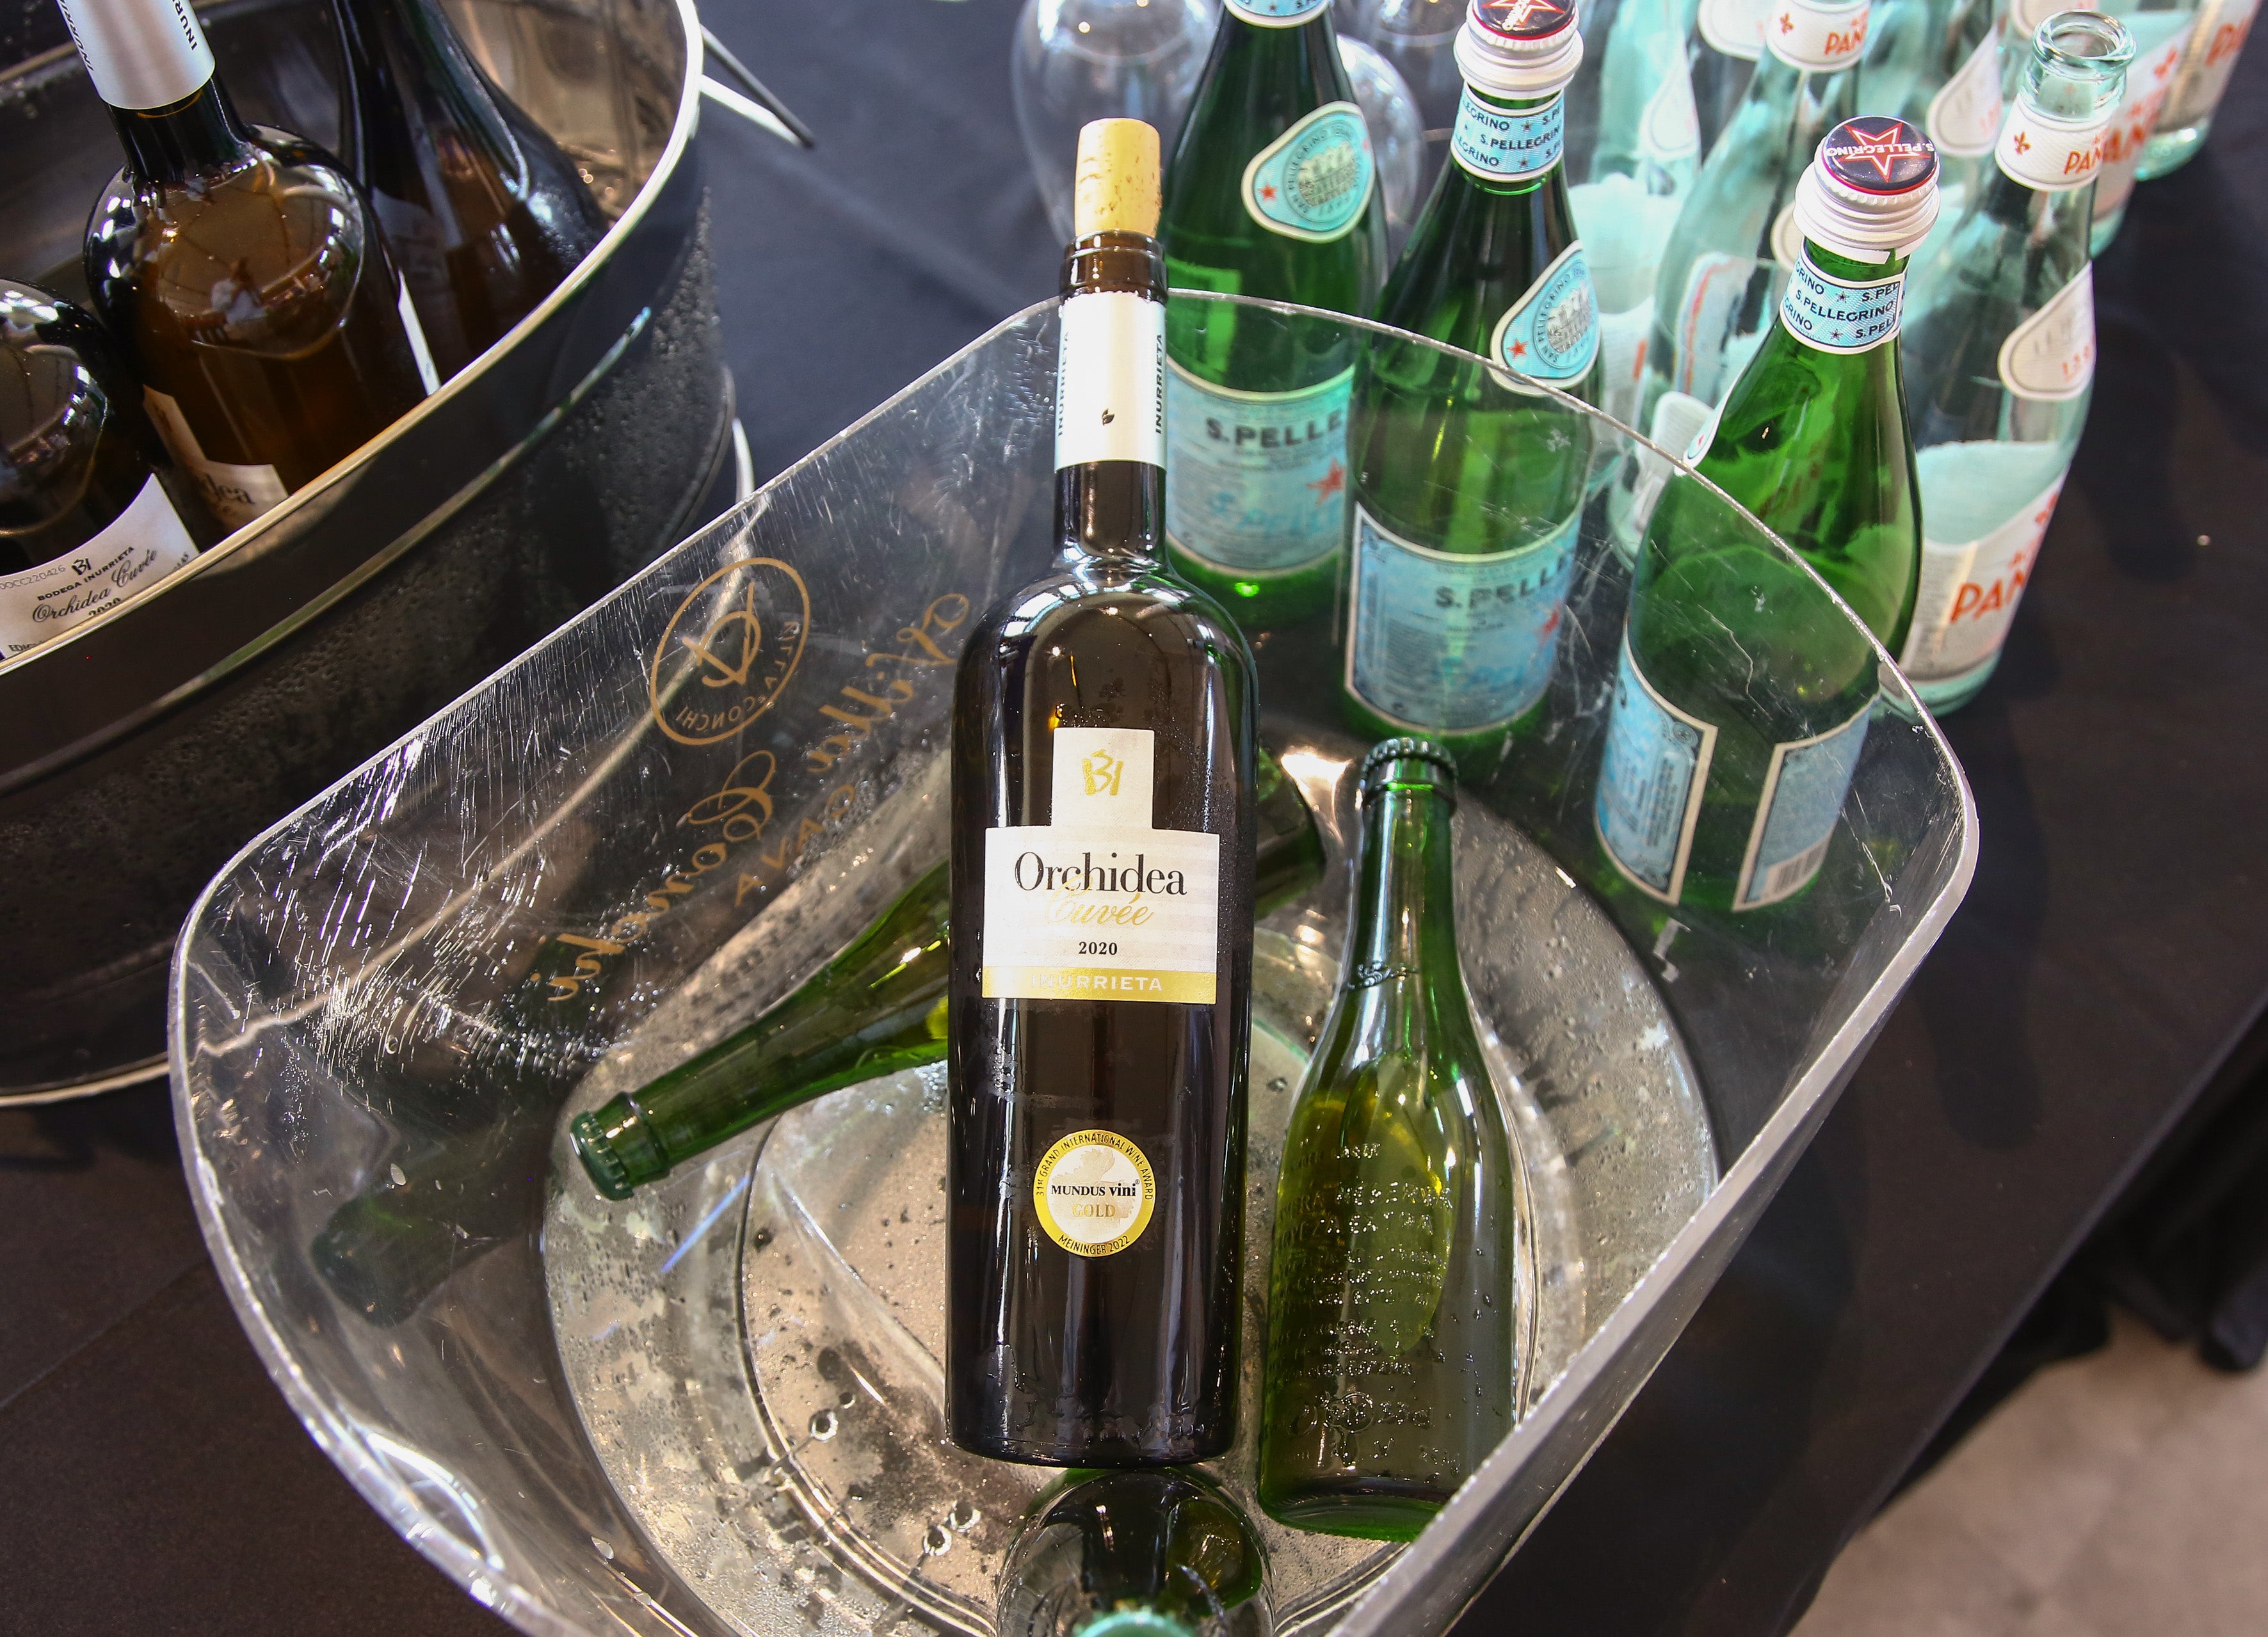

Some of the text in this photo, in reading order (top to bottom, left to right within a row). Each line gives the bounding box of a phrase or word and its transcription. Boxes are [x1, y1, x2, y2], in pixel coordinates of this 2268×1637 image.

[172, 0, 198, 51] INUR
[1826, 142, 1935, 157] S.PELLEGRINO
[1796, 289, 1894, 323] S.PELLEGRINO
[37, 546, 135, 602] BODEGA INURRIETA
[33, 586, 111, 623] Orchidea
[1014, 851, 1187, 895] Orchidea
[1042, 872, 1154, 926] Cuvée
[1078, 941, 1118, 955] 2020
[1031, 973, 1162, 991] INURRIETA
[1039, 1149, 1061, 1178] GRAND
[1061, 1132, 1125, 1151] INTERNATIONAL
[1125, 1145, 1145, 1167] WINE
[1140, 1168, 1154, 1201] AWARD
[1050, 1185, 1106, 1197] MUNDUS
[1072, 1203, 1116, 1218] GOLD
[1058, 1234, 1130, 1256] MEININGER 2022
